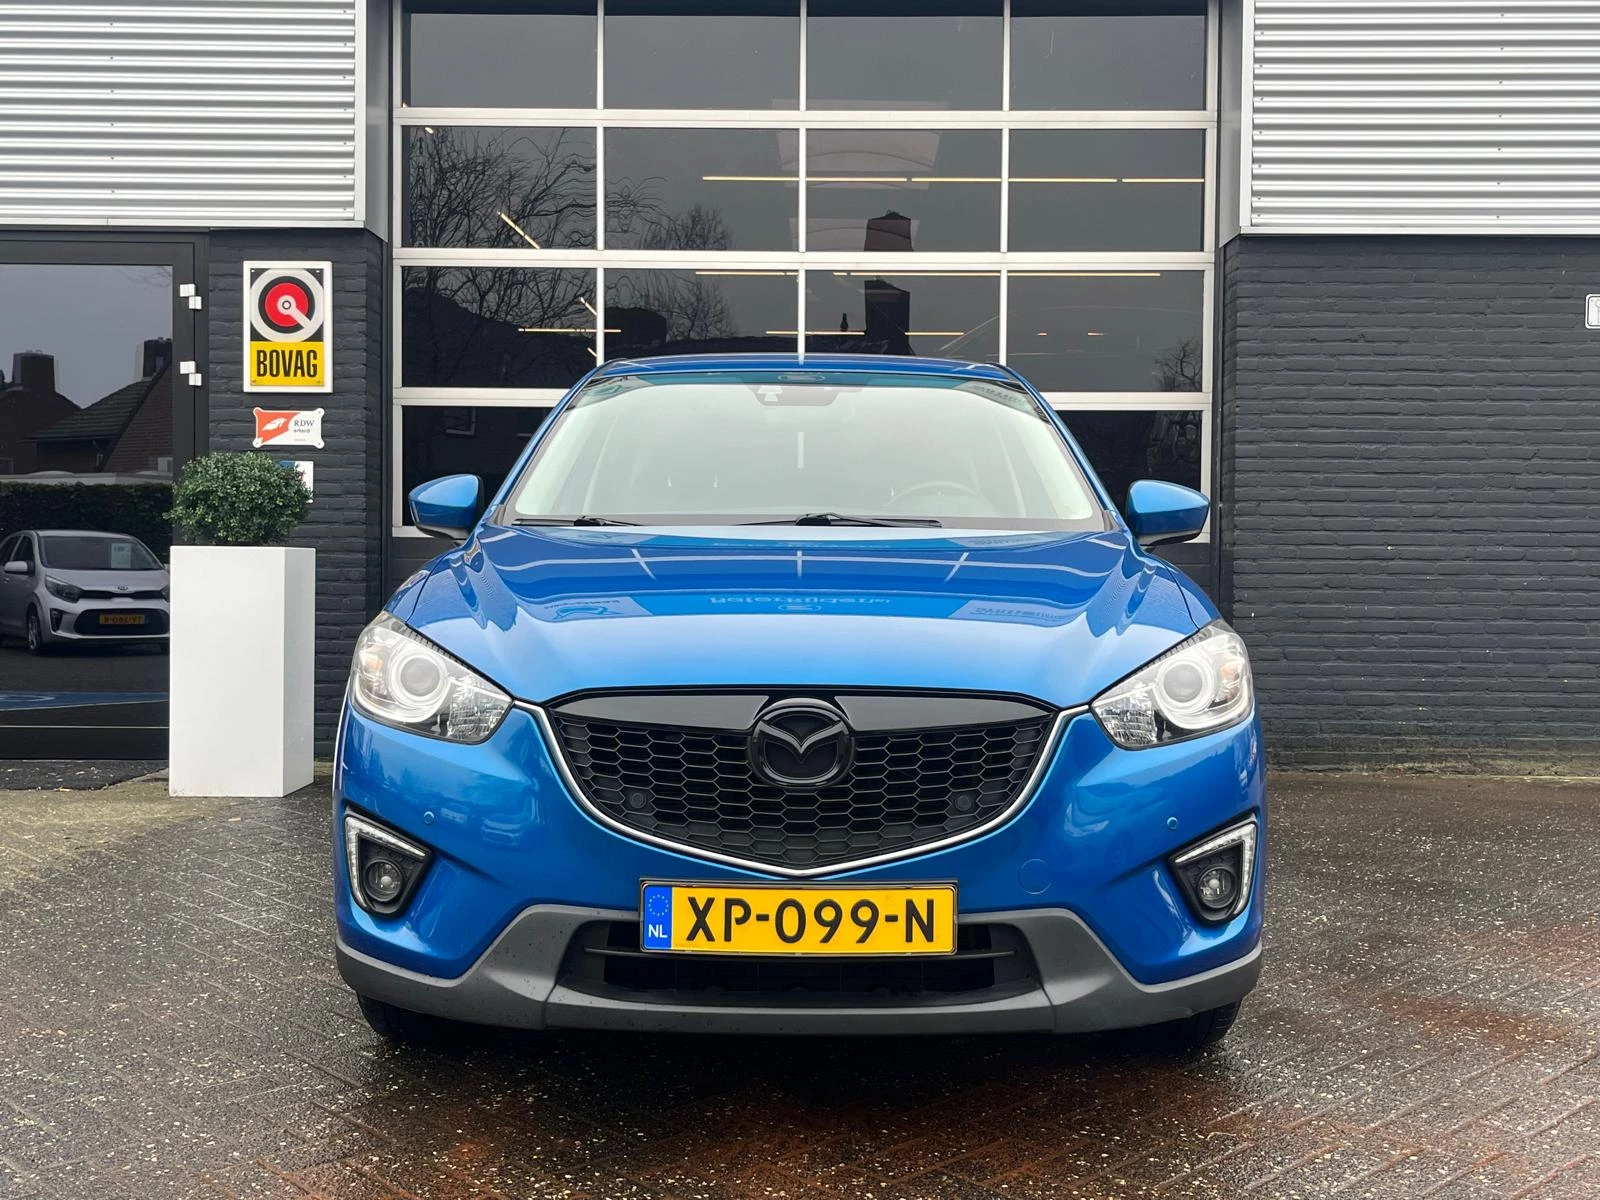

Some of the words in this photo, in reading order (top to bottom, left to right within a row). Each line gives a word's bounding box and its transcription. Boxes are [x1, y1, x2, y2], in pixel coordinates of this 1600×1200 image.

[256, 349, 318, 378] BOVAG
[293, 419, 315, 427] RDW
[685, 896, 934, 944] XP-099-N
[648, 924, 668, 938] NL
